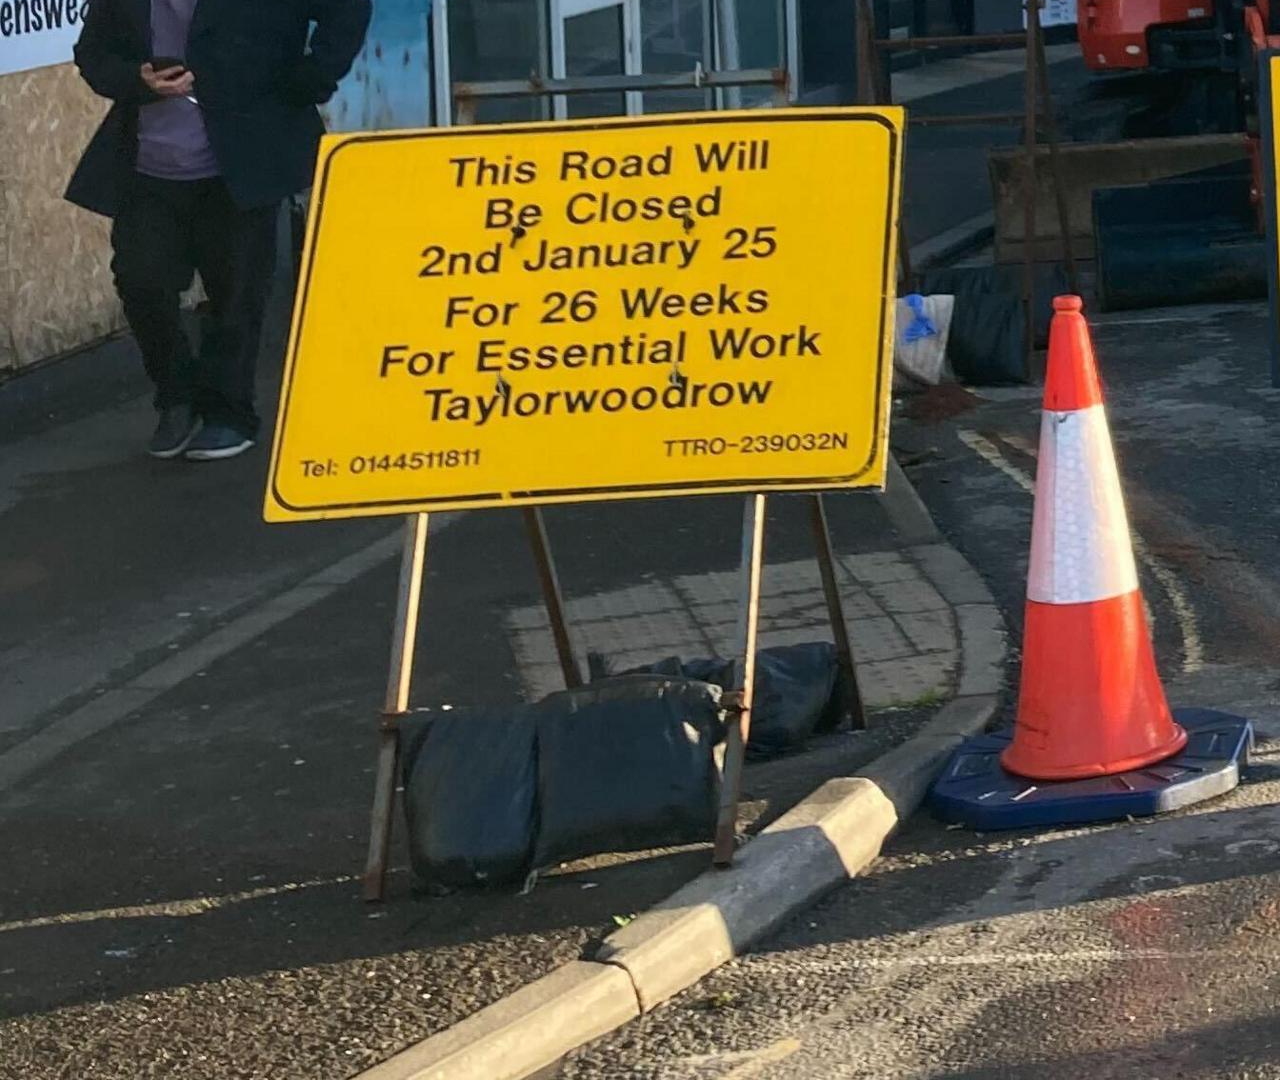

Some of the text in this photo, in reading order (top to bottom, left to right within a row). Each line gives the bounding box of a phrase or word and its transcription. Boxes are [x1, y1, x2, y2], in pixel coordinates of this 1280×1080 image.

[450, 140, 771, 190] This Road Will
[485, 186, 723, 230] Be Closed
[418, 226, 778, 280] 2nd January 25
[444, 282, 771, 330] For 26 Weeks
[379, 325, 822, 379] For Essential Work
[424, 376, 774, 428] Taylorwoodrow
[299, 432, 849, 479] Tel: 0144511811 TTRO-239032N
